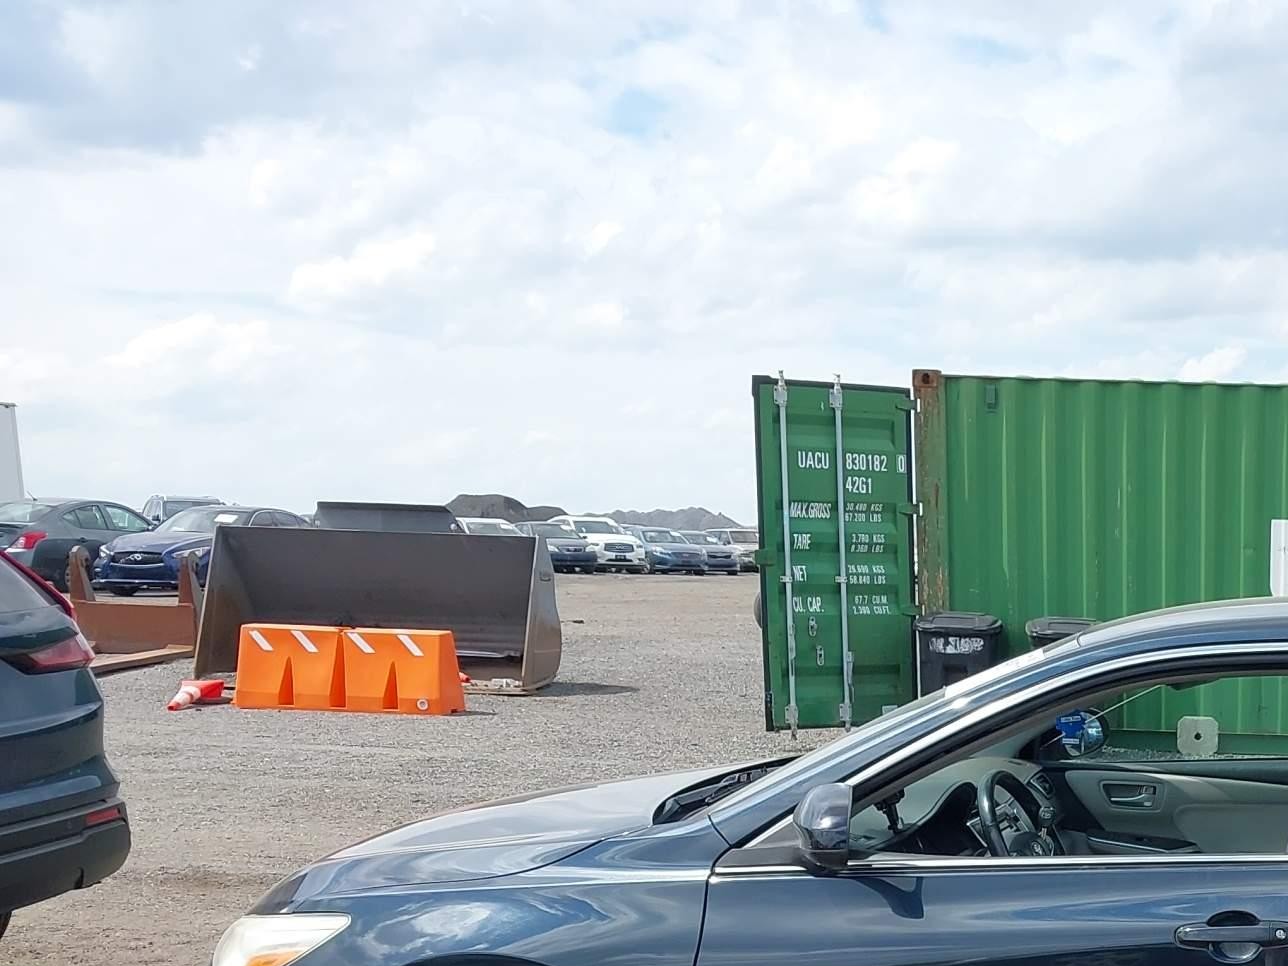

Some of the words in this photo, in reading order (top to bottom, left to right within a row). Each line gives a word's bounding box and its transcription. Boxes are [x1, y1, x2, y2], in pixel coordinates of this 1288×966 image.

[797, 450, 830, 469] UACU
[845, 453, 888, 472] 830182
[897, 454, 906, 473] 0
[845, 476, 872, 494] 42G1
[870, 503, 884, 512] KGS
[869, 513, 882, 523] LBS
[793, 533, 812, 550] TARE
[873, 534, 885, 543] KGS
[792, 565, 807, 582] NET
[807, 596, 825, 613] CAP.
